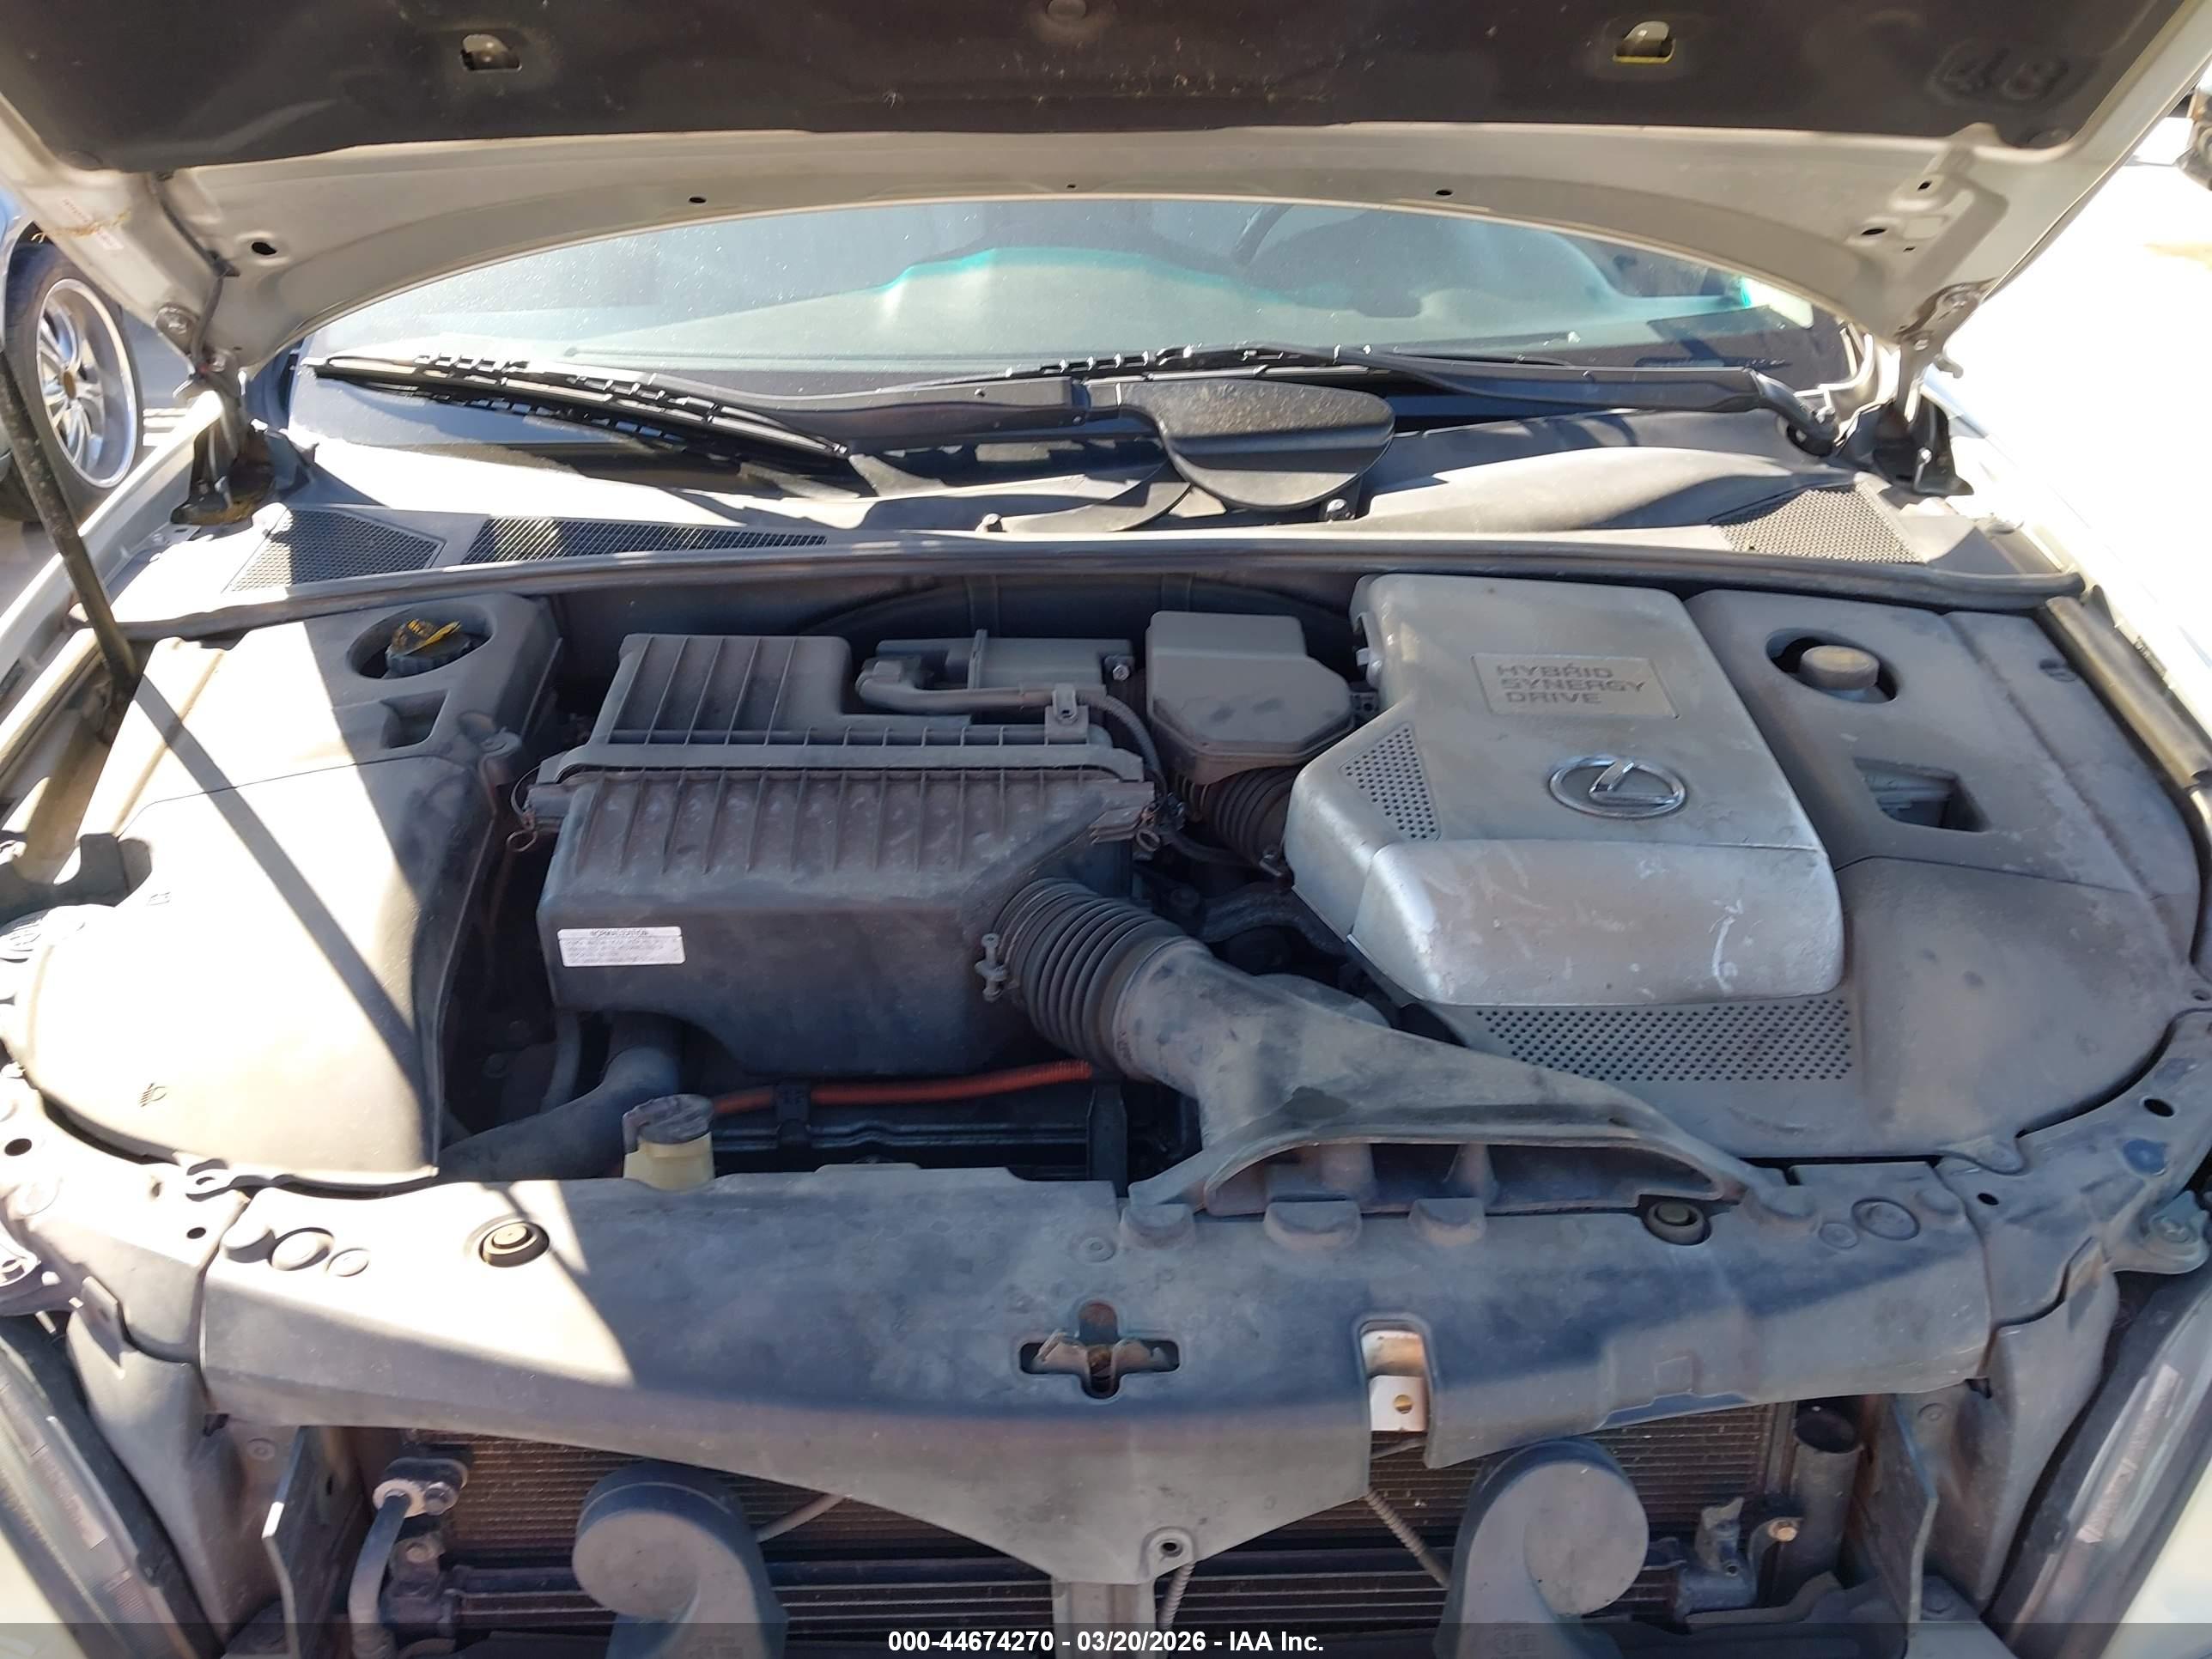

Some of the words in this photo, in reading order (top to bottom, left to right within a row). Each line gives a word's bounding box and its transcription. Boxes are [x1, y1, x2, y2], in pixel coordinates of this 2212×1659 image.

[1497, 665, 1613, 678] HYBRID
[1501, 678, 1645, 692] SYNERGY
[1505, 691, 1602, 704] DRIVE
